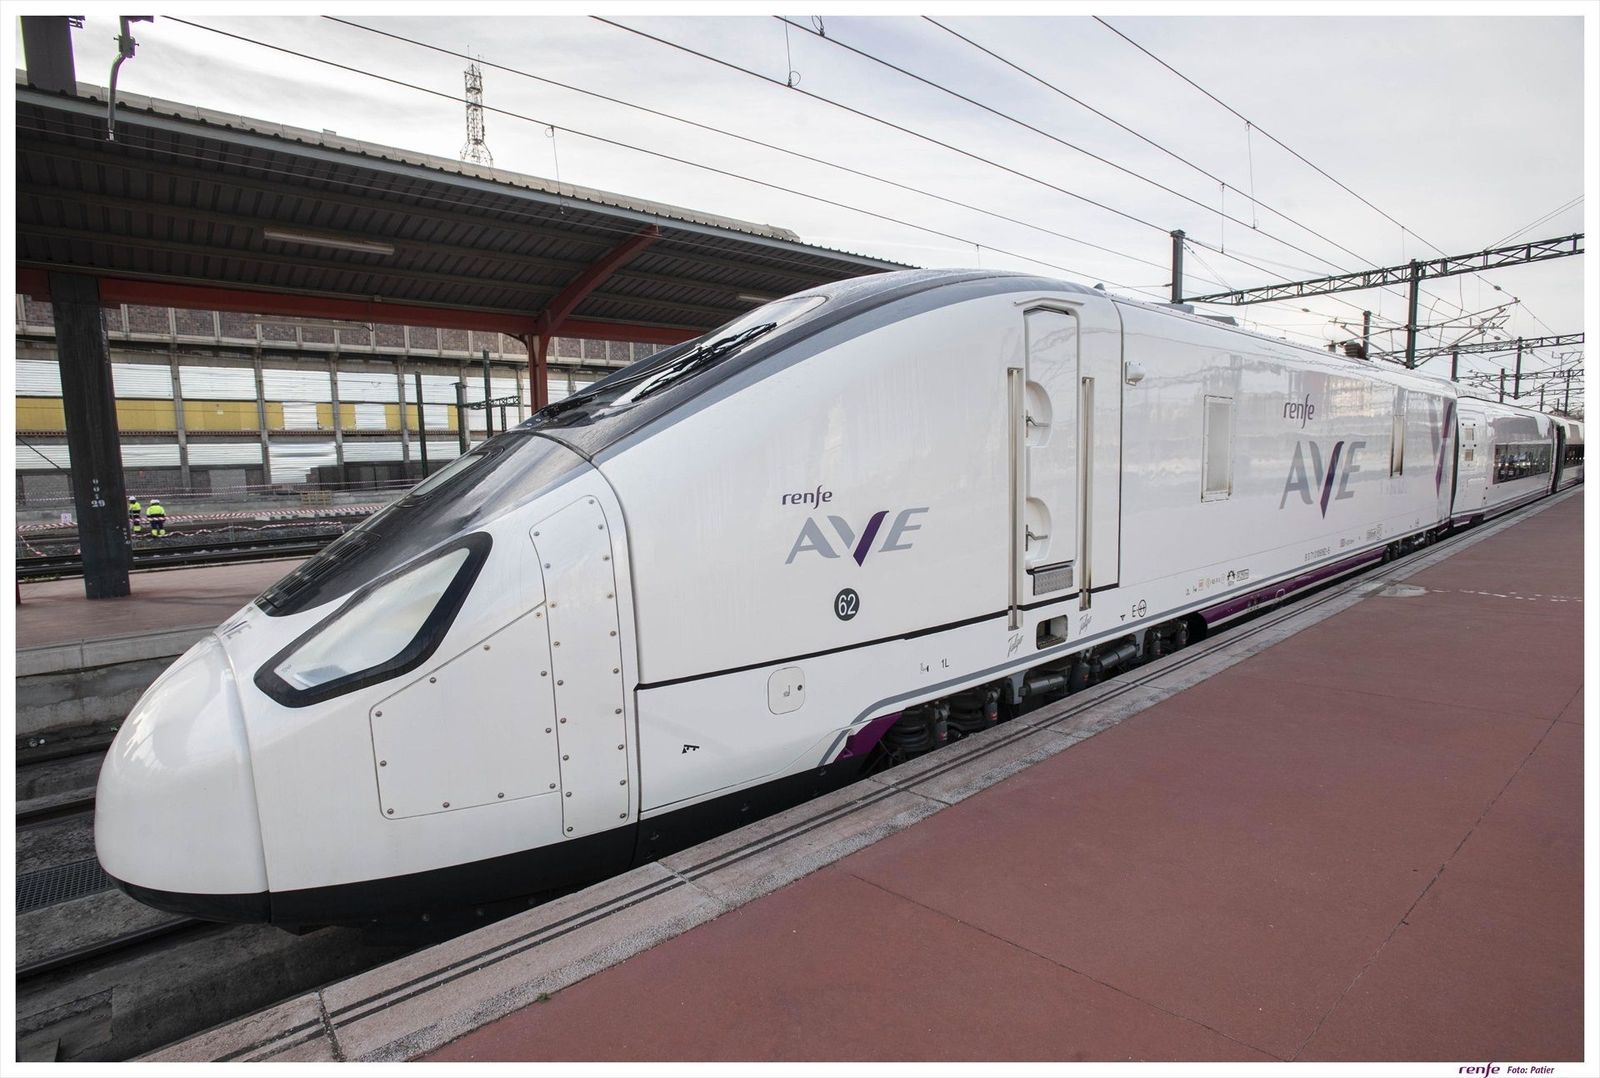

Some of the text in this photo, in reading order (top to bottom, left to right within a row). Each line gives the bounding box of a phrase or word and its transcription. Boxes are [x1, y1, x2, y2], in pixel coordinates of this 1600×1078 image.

[1283, 393, 1315, 429] renfe
[1279, 440, 1366, 519] AVE
[781, 484, 833, 510] renfe
[785, 507, 930, 567] AVE
[838, 593, 856, 616] 62
[941, 658, 950, 669] 1L
